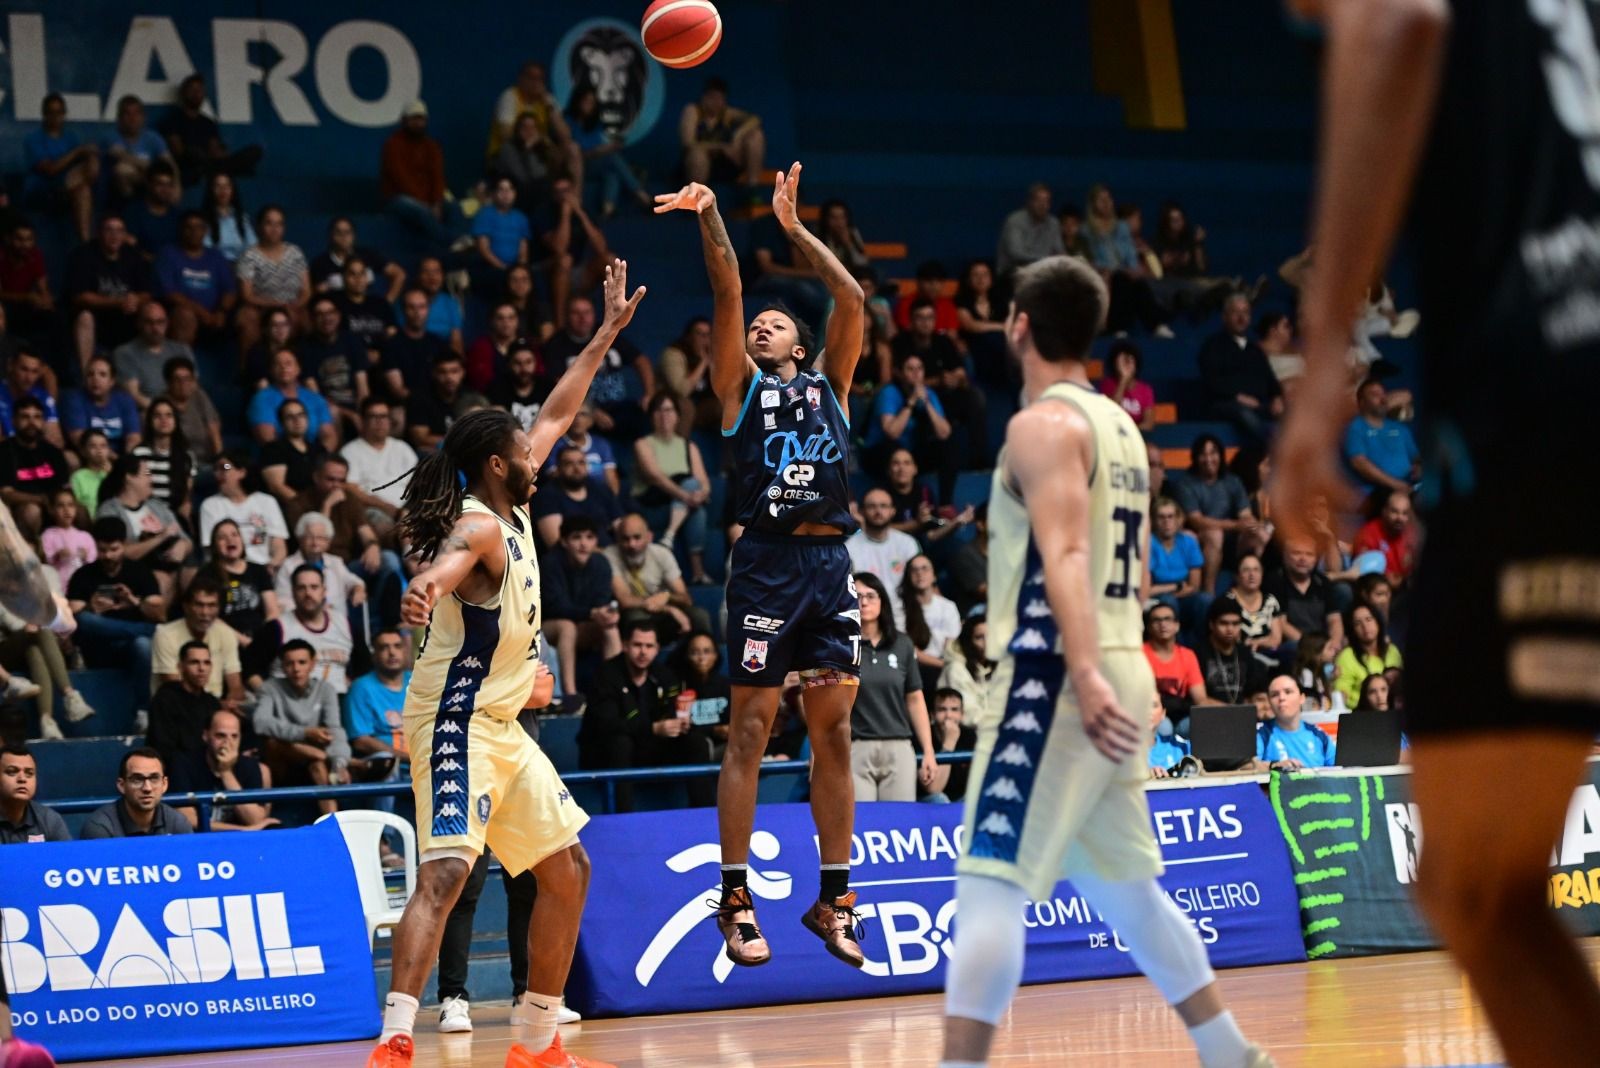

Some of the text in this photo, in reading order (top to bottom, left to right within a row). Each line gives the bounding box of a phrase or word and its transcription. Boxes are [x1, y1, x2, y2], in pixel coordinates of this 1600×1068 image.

[0, 13, 422, 128] LARO
[764, 424, 842, 475] Pato
[813, 804, 1243, 866] ORMA ETAS
[44, 861, 236, 888] GOVERNO DO
[1022, 881, 1261, 928] COMI ASILEIRO
[0, 891, 325, 995] BRASIL
[1088, 932, 1108, 948] DE
[46, 1006, 100, 1025] LADO
[108, 1003, 137, 1021] DO
[144, 1000, 199, 1018] POVO
[206, 992, 317, 1015] BRASILEIRO
